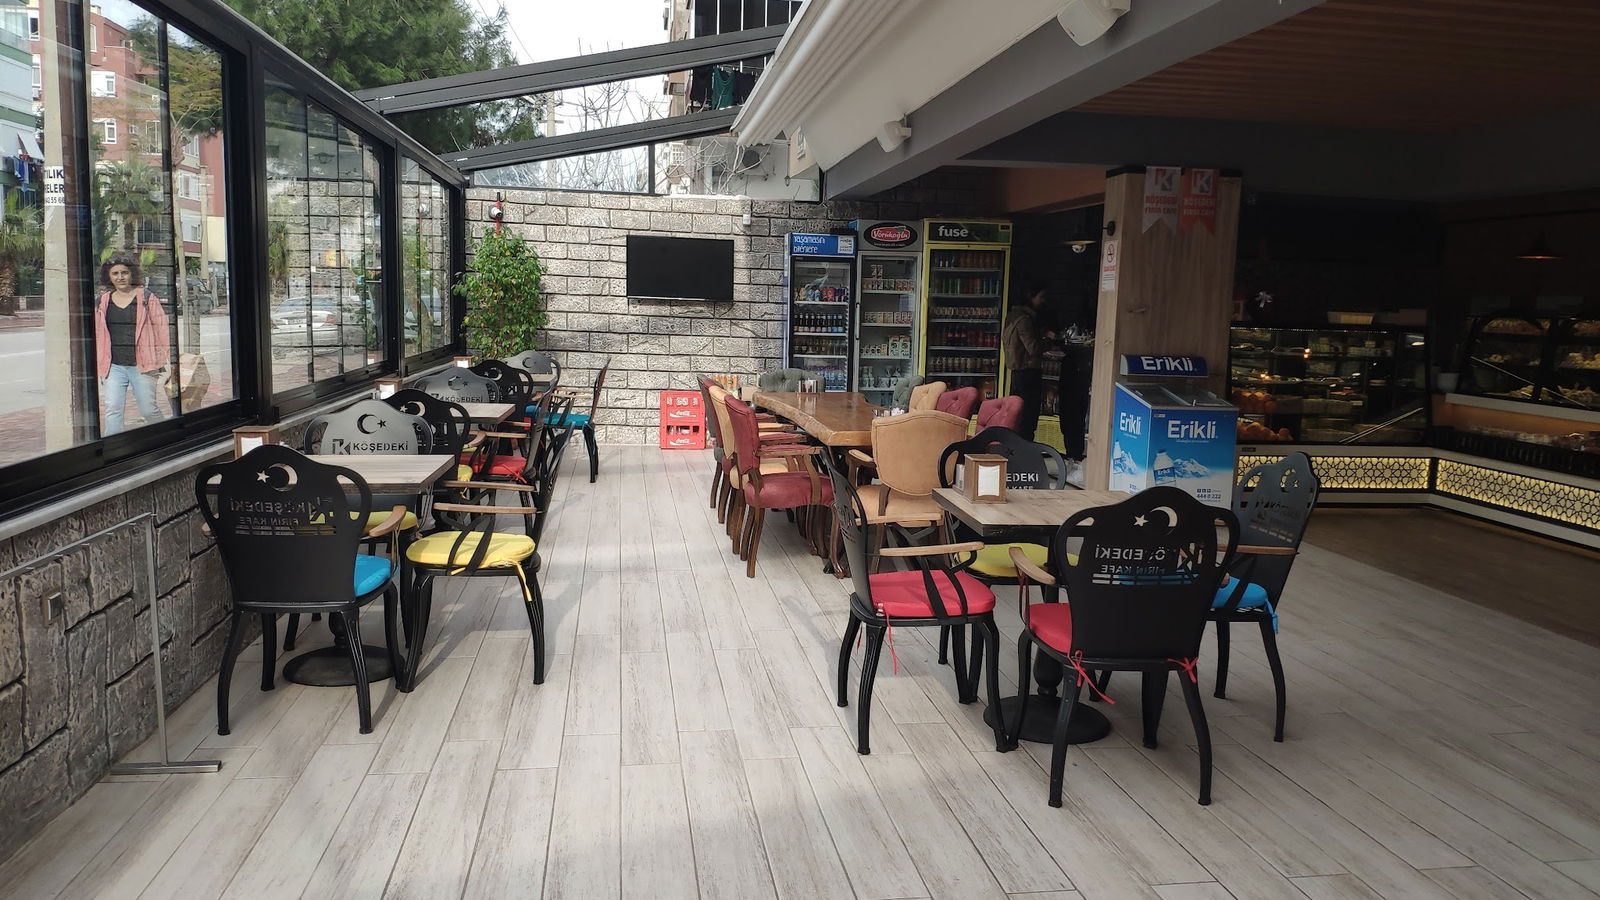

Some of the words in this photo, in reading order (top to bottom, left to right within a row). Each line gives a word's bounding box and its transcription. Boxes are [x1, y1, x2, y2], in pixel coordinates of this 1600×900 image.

[938, 225, 969, 238] fuse
[1141, 356, 1194, 371] Erikli
[1119, 412, 1141, 435] Erikli
[1167, 420, 1217, 439] Erikli
